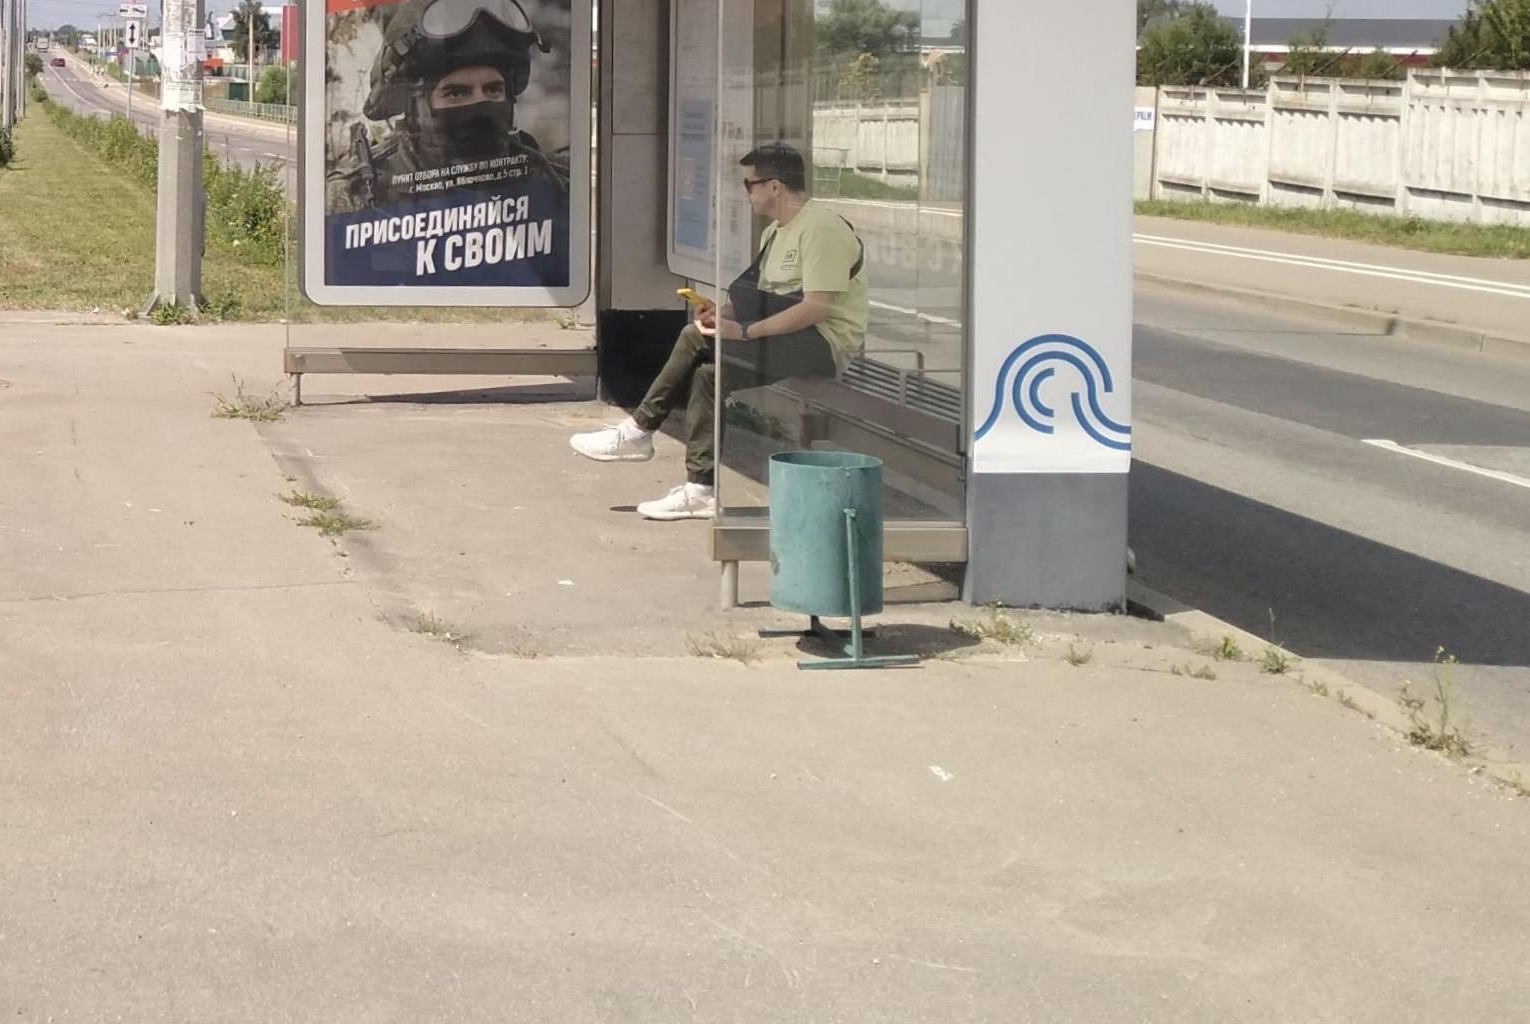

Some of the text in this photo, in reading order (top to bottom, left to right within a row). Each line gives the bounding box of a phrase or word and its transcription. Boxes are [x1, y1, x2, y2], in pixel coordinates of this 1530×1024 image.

[345, 194, 530, 249] ПРИСОЕДИНЯЙСЯ
[416, 219, 553, 276] К СВОИМ
